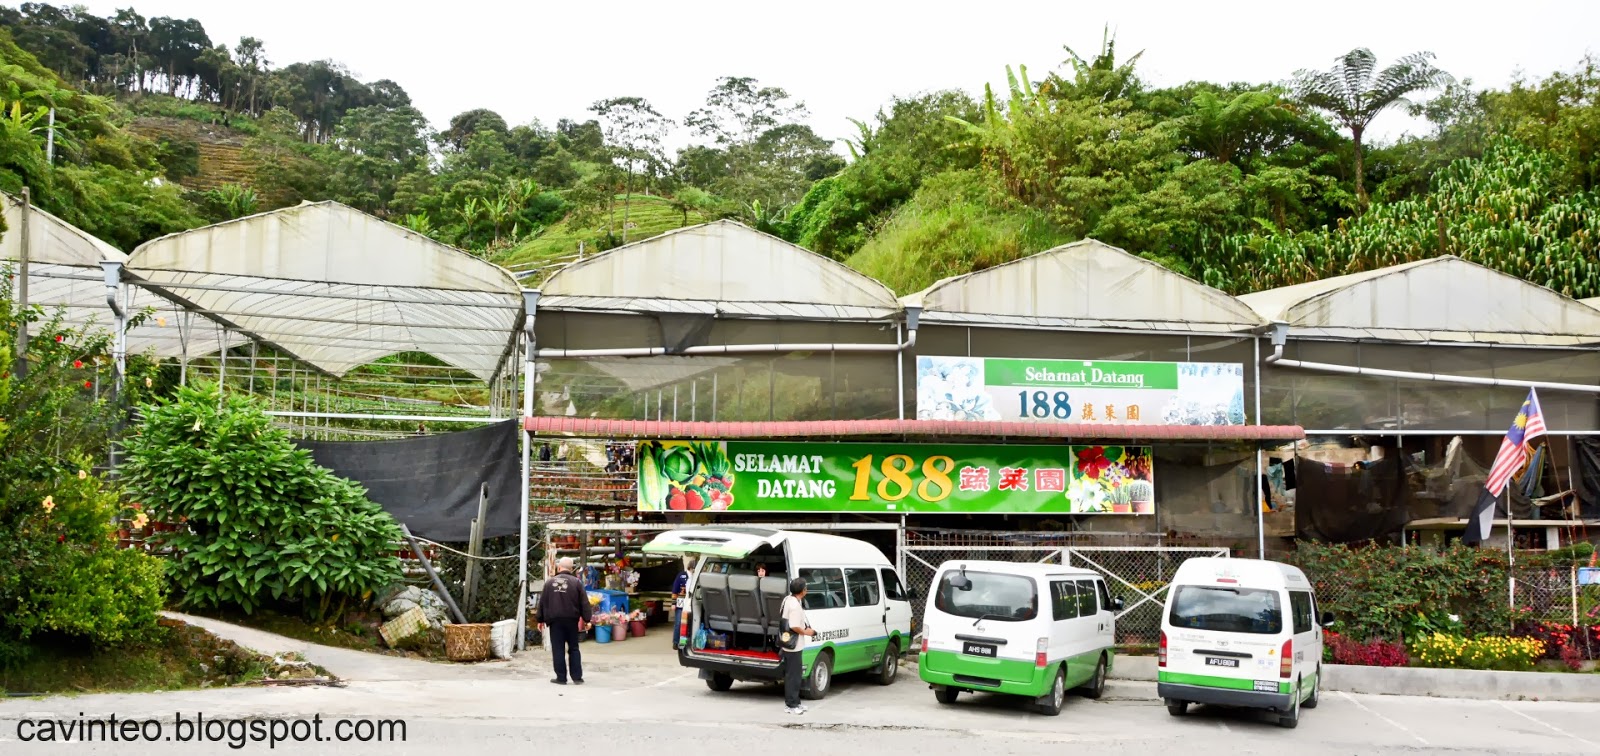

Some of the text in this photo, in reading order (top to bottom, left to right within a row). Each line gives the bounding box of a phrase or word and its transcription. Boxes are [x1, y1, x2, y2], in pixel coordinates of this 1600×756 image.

[1025, 366, 1144, 387] Selamat Datang
[1018, 390, 1072, 420] 188
[734, 453, 823, 474] SELAMAT
[849, 454, 1066, 502] 188 蔬菜園
[757, 479, 837, 499] DATANG
